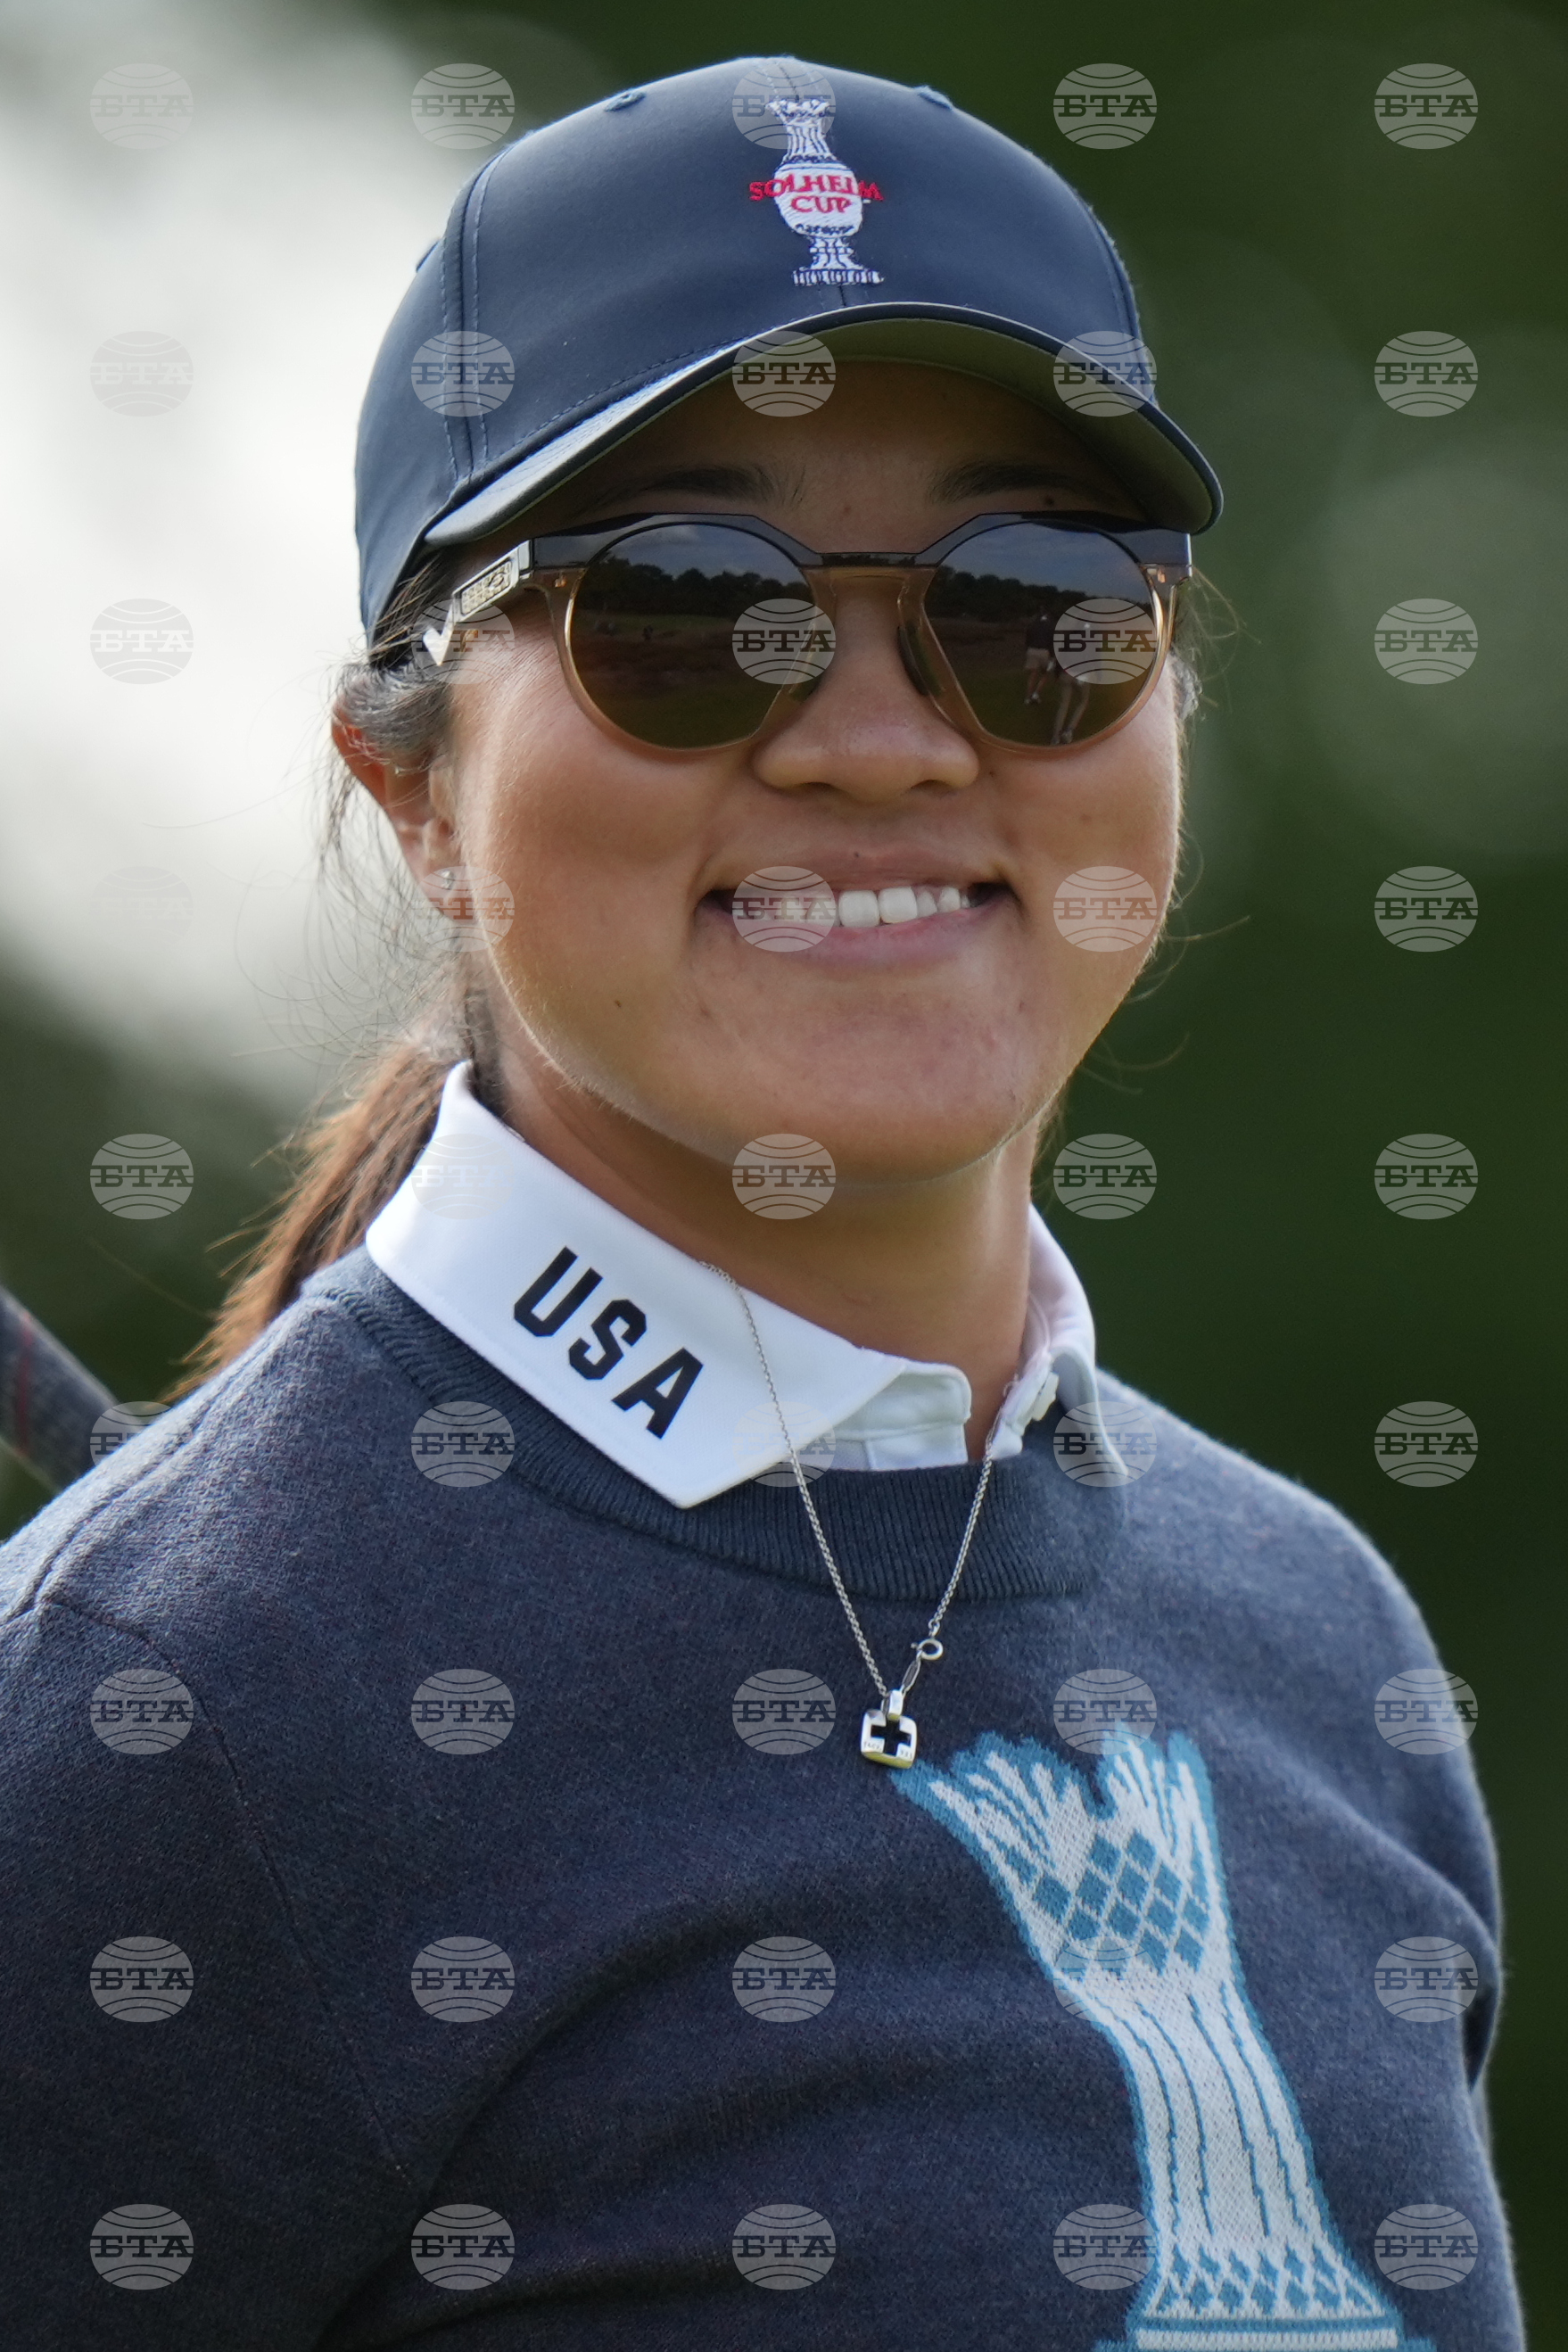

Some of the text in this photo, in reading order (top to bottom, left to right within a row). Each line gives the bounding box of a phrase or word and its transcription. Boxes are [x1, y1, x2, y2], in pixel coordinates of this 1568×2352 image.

[749, 173, 885, 202] SOLHEIM
[790, 195, 853, 214] CUP
[514, 1246, 704, 1440] USA
